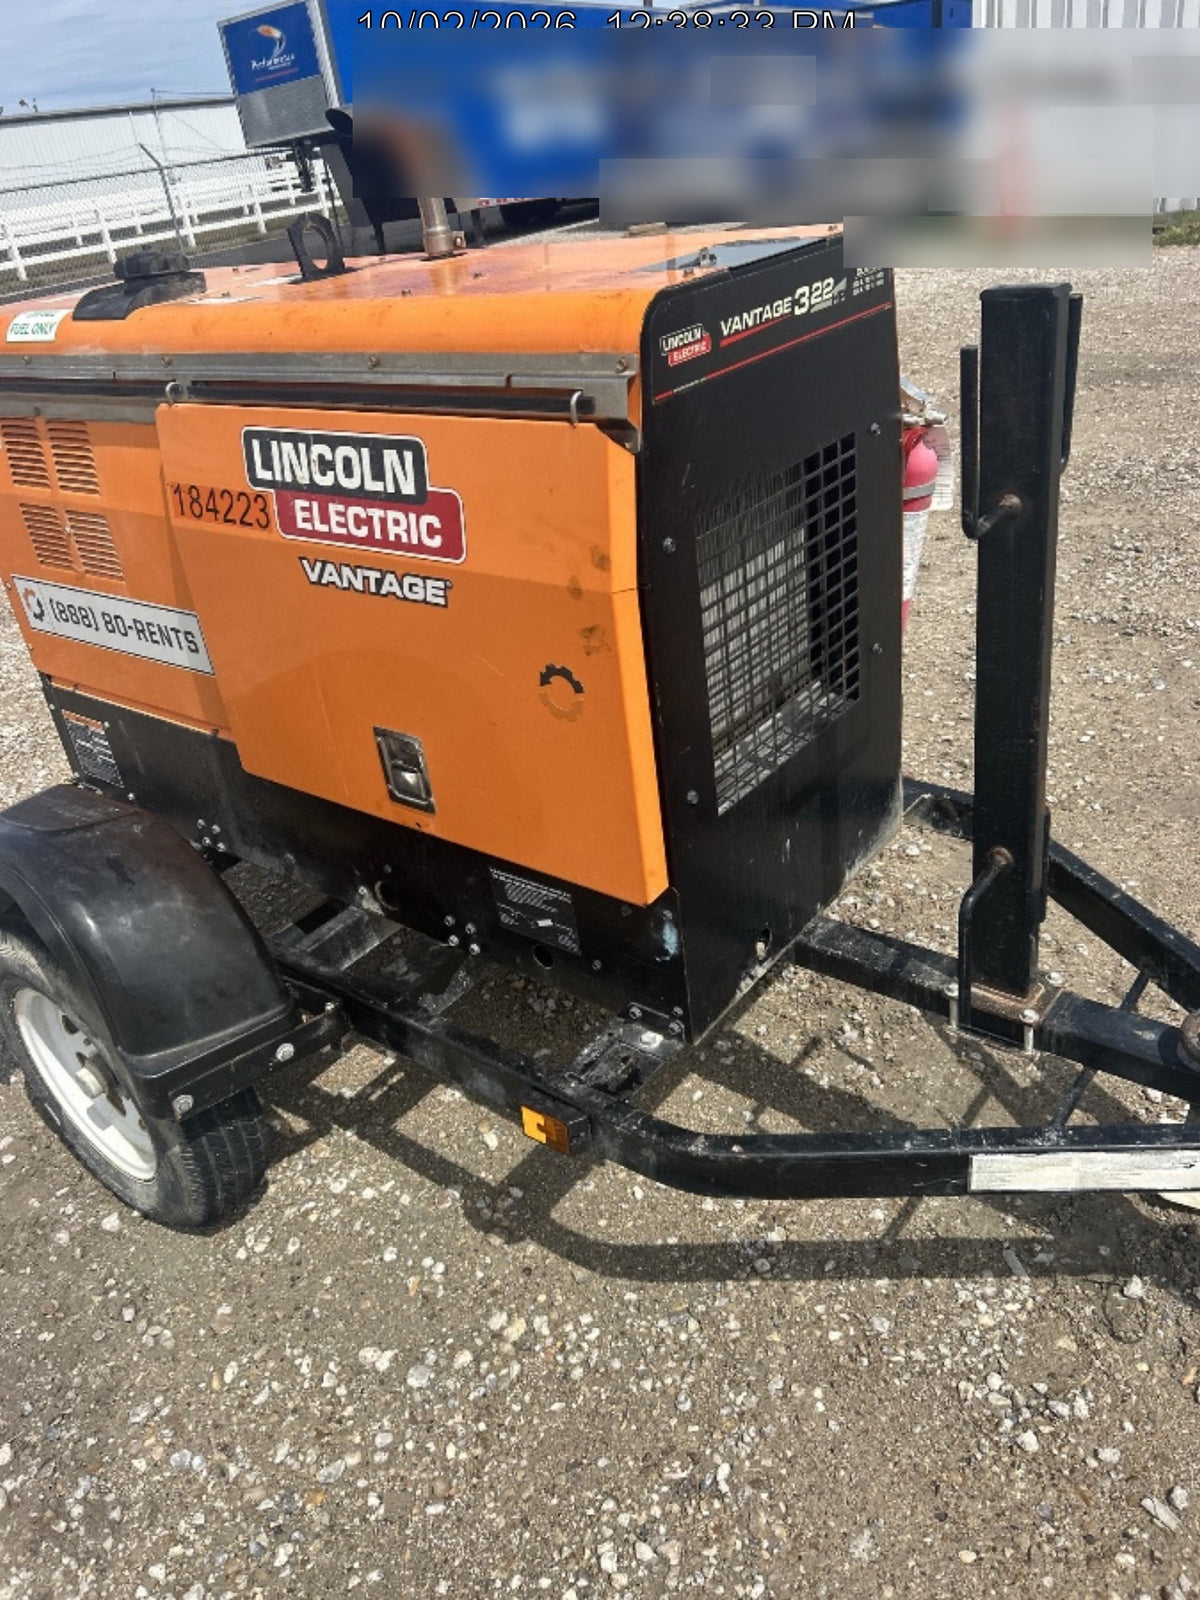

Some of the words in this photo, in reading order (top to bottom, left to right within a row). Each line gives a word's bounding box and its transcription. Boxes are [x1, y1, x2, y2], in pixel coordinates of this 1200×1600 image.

[720, 296, 793, 337] VANTAGE
[793, 276, 835, 315] 322
[663, 327, 702, 351] LINCOLN
[252, 439, 416, 495] LINCOLN
[173, 484, 270, 529] 184223
[294, 499, 443, 548] ELECTRIC
[299, 557, 448, 607] VANTAGE
[50, 598, 99, 632] (888)
[102, 611, 200, 654] 80-RENTS
